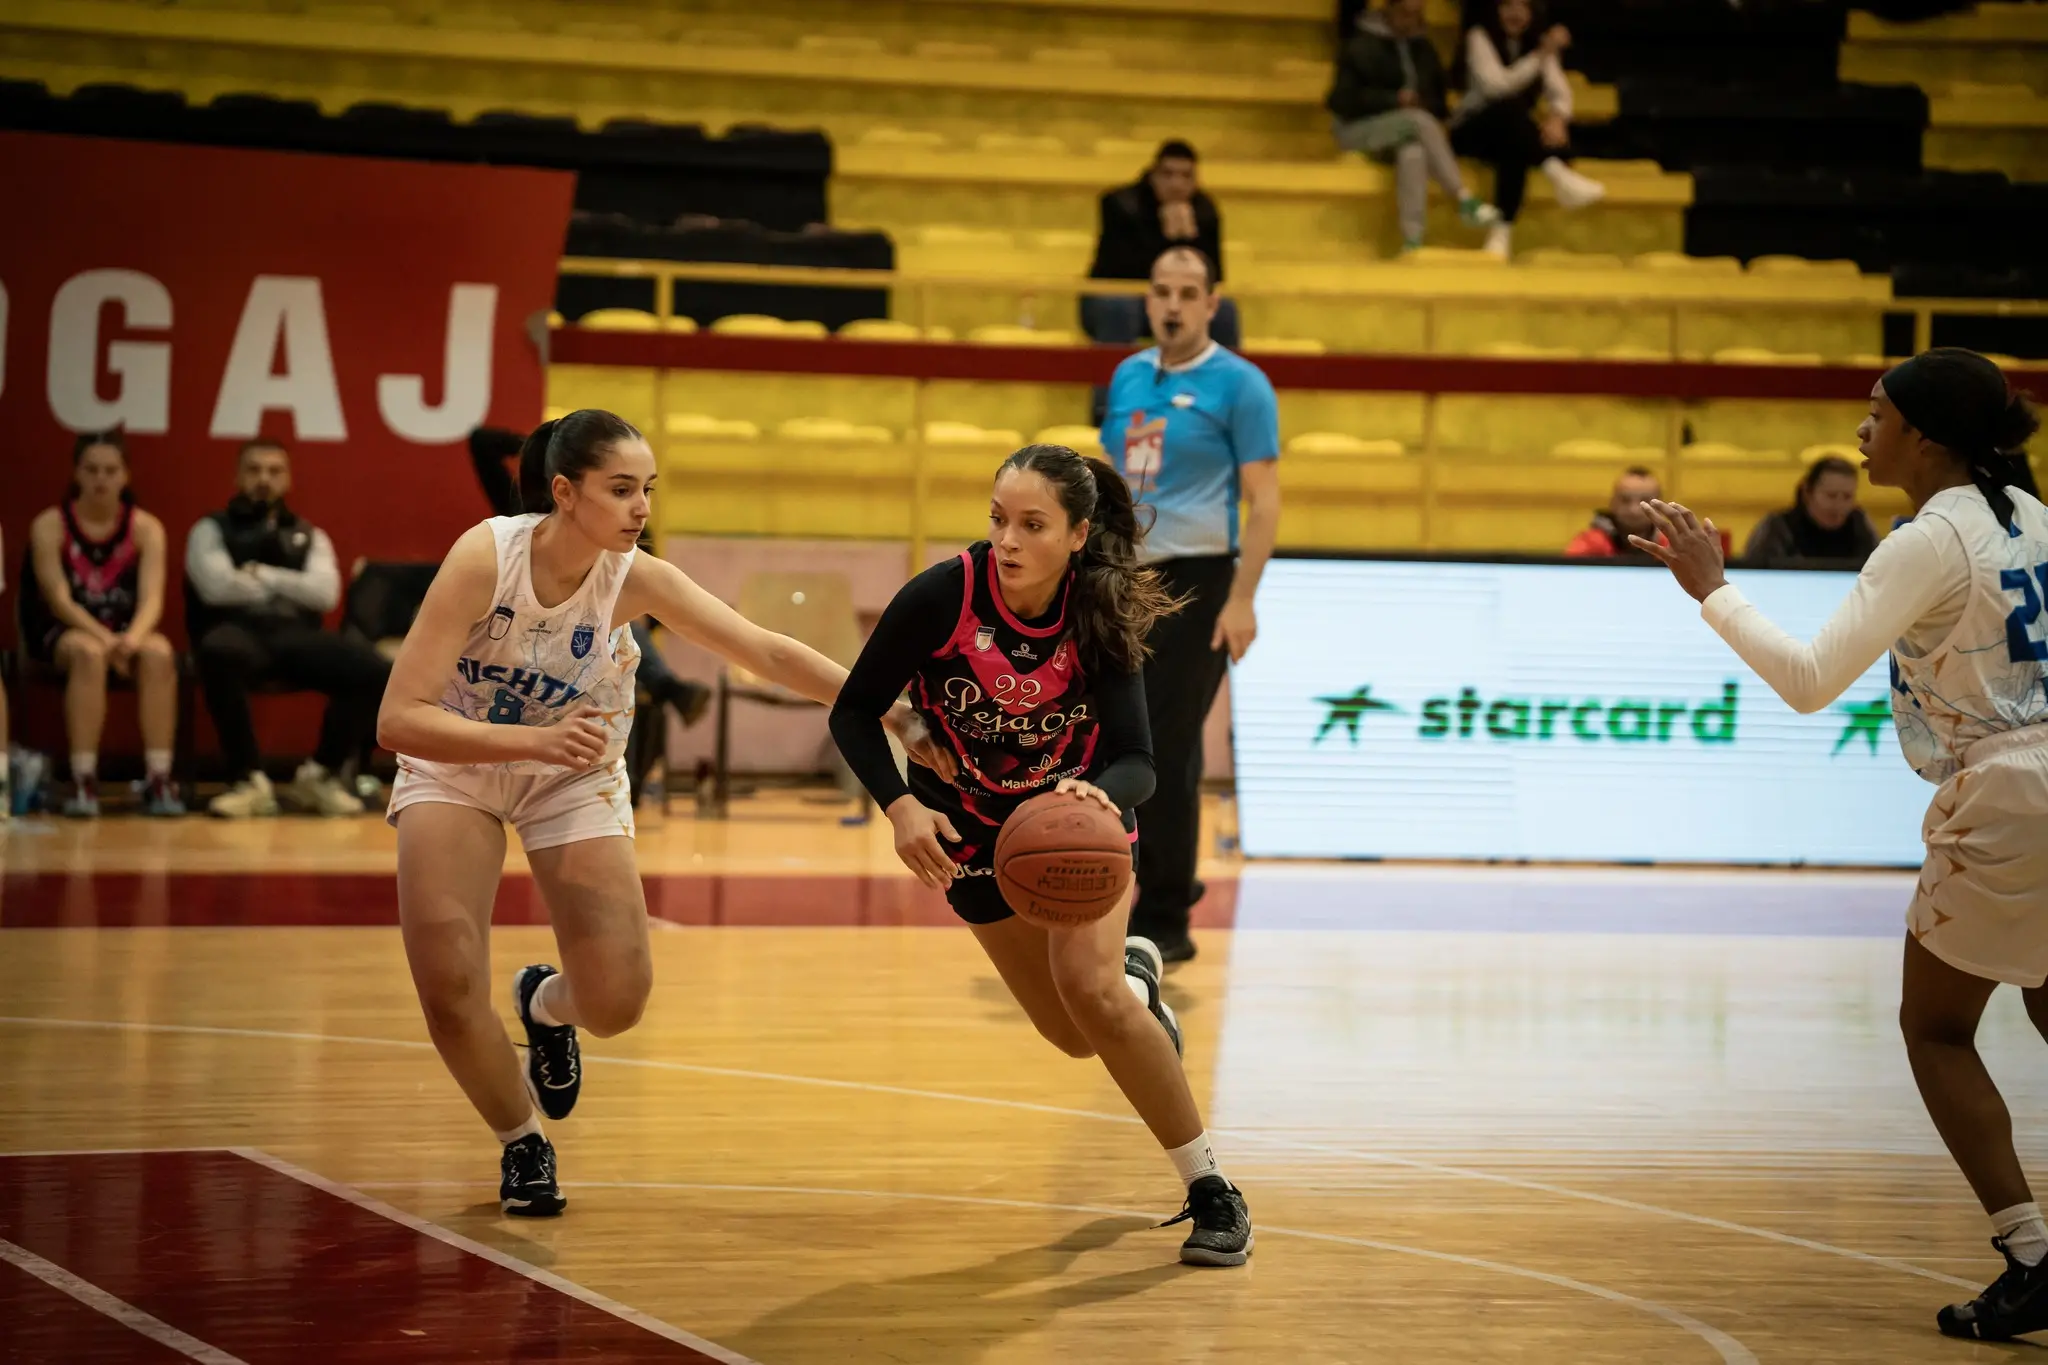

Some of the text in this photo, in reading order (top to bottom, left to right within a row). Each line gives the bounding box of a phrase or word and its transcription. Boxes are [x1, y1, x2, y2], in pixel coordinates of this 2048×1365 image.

[0, 266, 499, 445] GAJ
[487, 687, 526, 724] 8
[944, 676, 1035, 733] Peja
[992, 674, 1043, 709] 22
[1416, 678, 1738, 744] starcard
[1001, 764, 1086, 790] MatkosPharm
